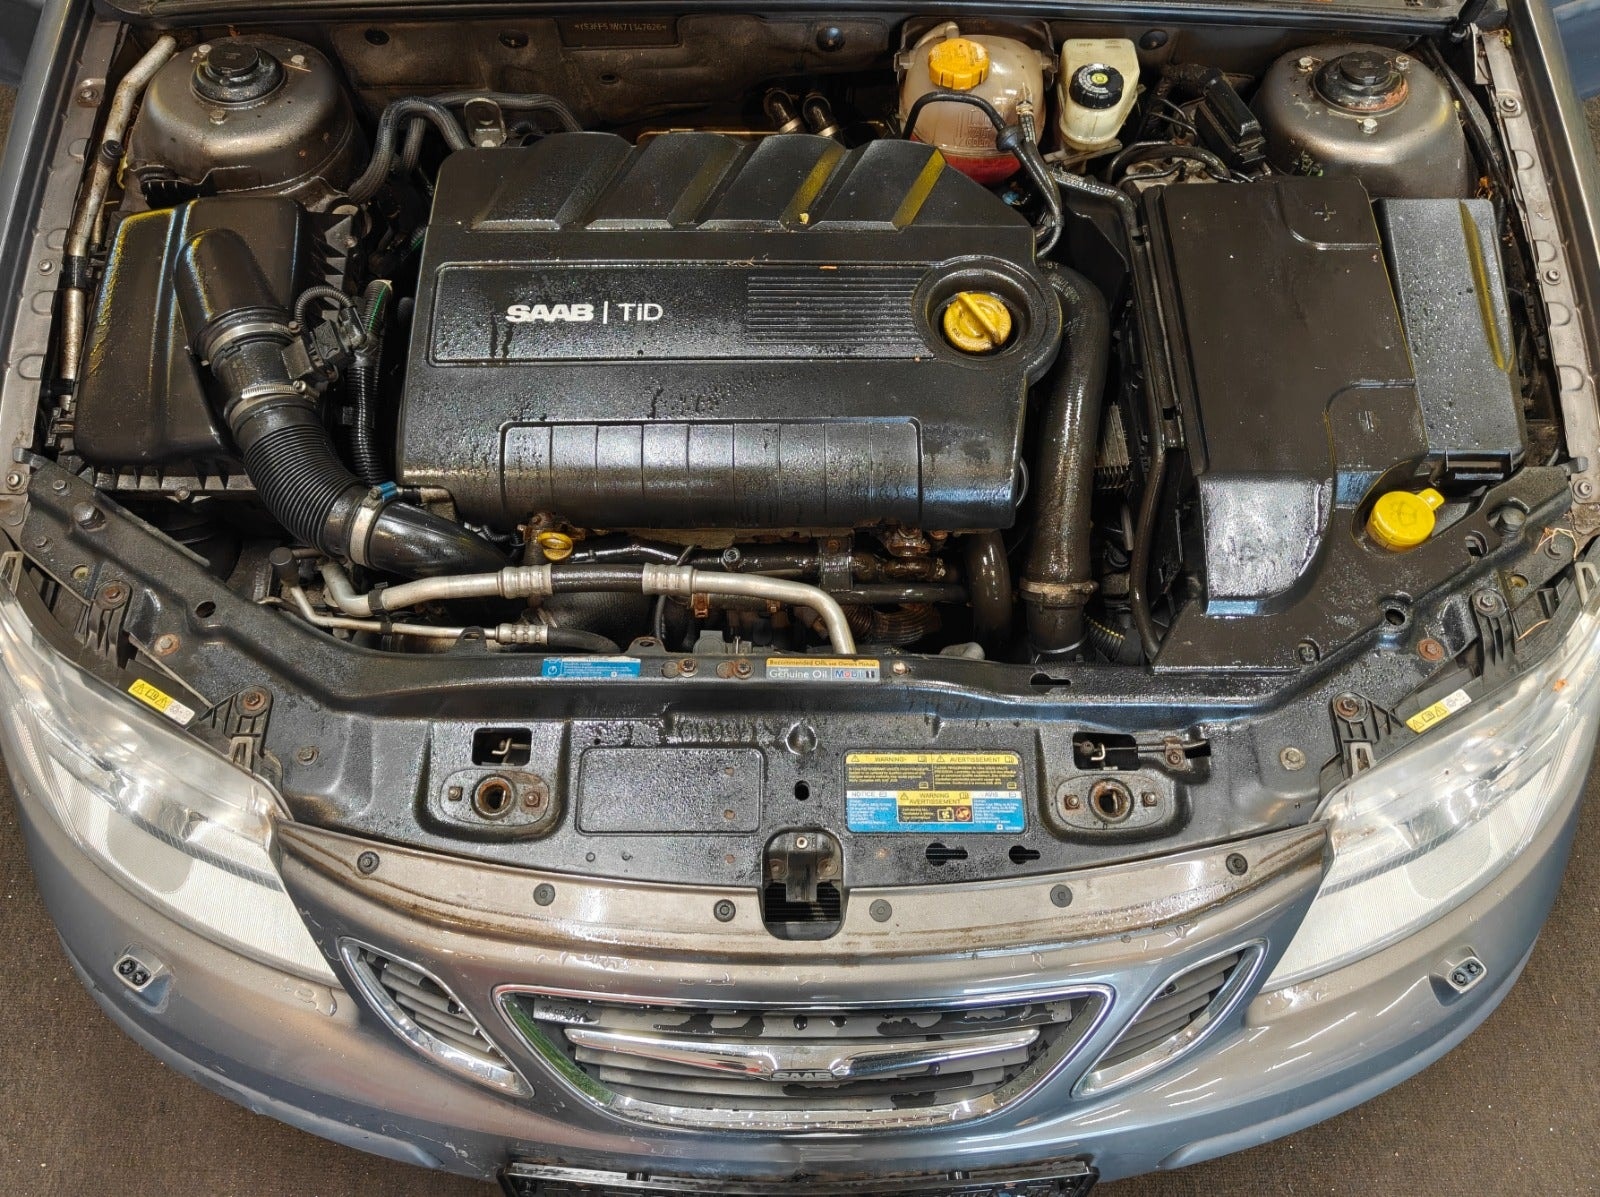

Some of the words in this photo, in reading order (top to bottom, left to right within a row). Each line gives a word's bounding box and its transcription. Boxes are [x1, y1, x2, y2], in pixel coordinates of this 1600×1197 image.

[505, 303, 594, 322] SAAB
[769, 670, 809, 679] Genuine
[812, 669, 827, 679] Oil
[771, 1072, 833, 1082] SAAB
